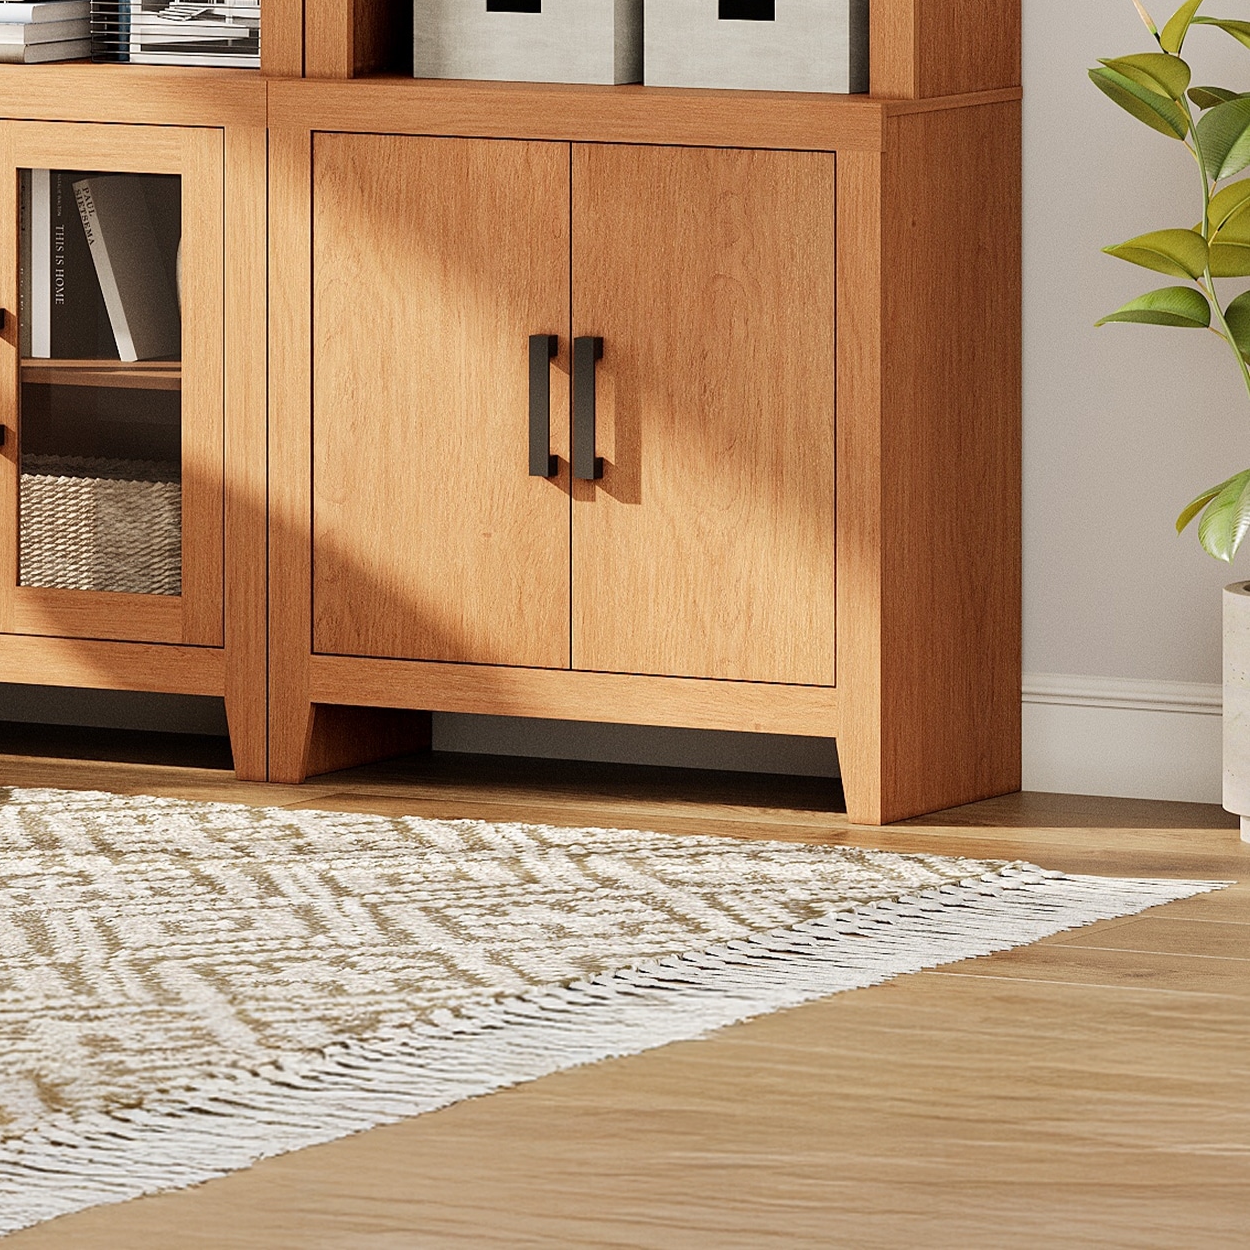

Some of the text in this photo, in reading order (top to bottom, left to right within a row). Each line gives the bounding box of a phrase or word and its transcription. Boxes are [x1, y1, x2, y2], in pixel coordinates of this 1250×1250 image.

[76, 189, 95, 245] SIETSEMA
[82, 187, 95, 217] PAUL
[55, 224, 64, 305] THIS IS HOME
